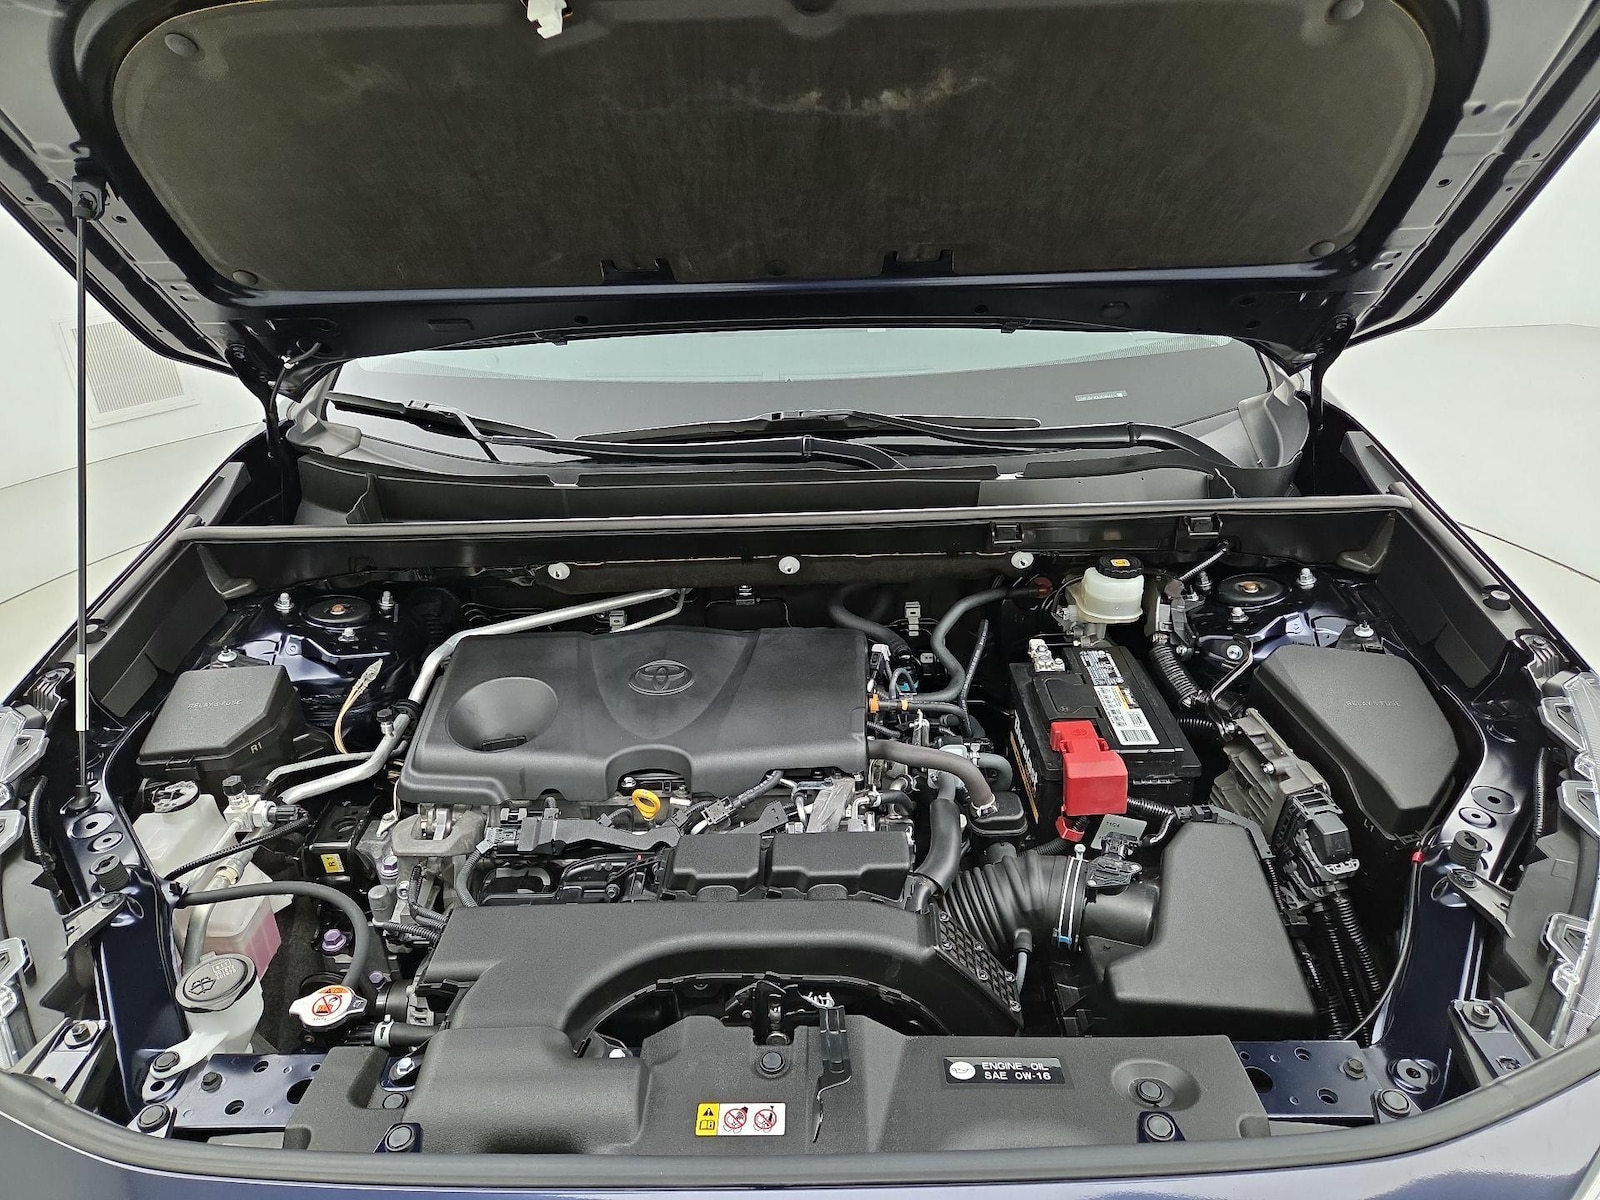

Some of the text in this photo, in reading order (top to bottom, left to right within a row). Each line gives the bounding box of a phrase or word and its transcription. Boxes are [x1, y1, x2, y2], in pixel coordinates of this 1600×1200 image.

[250, 741, 263, 754] R1
[1363, 818, 1375, 833] L1
[981, 1061, 1050, 1072] ENGINE OIL
[984, 1071, 1052, 1081] SAE 0W-16
